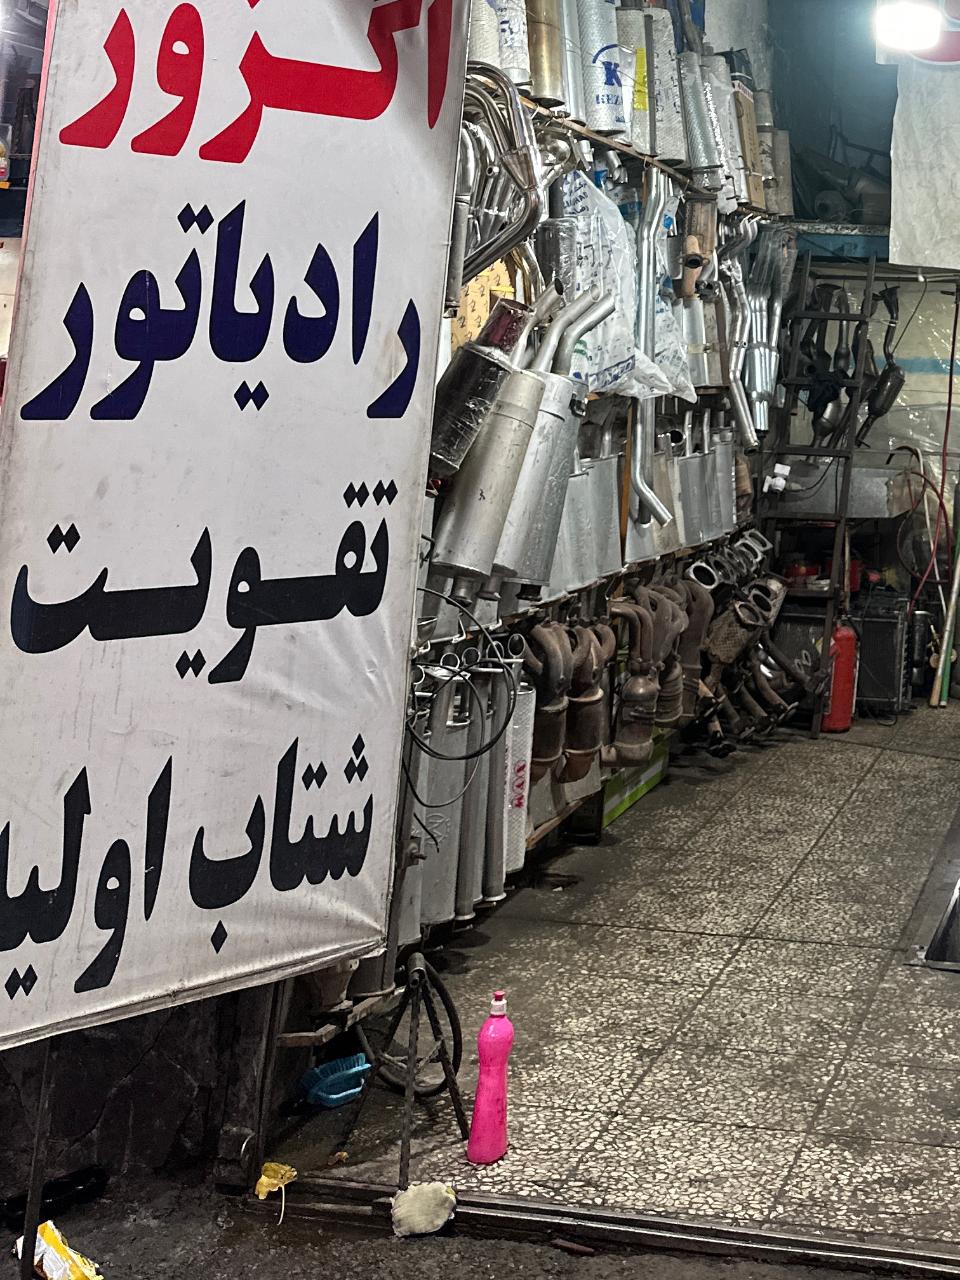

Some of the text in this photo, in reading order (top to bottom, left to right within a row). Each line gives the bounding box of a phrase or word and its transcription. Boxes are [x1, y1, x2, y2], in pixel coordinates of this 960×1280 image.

[20, 199, 421, 420] رادیاتور
[11, 480, 398, 684] تقویت
[0, 734, 373, 1000] شتاب اولی
